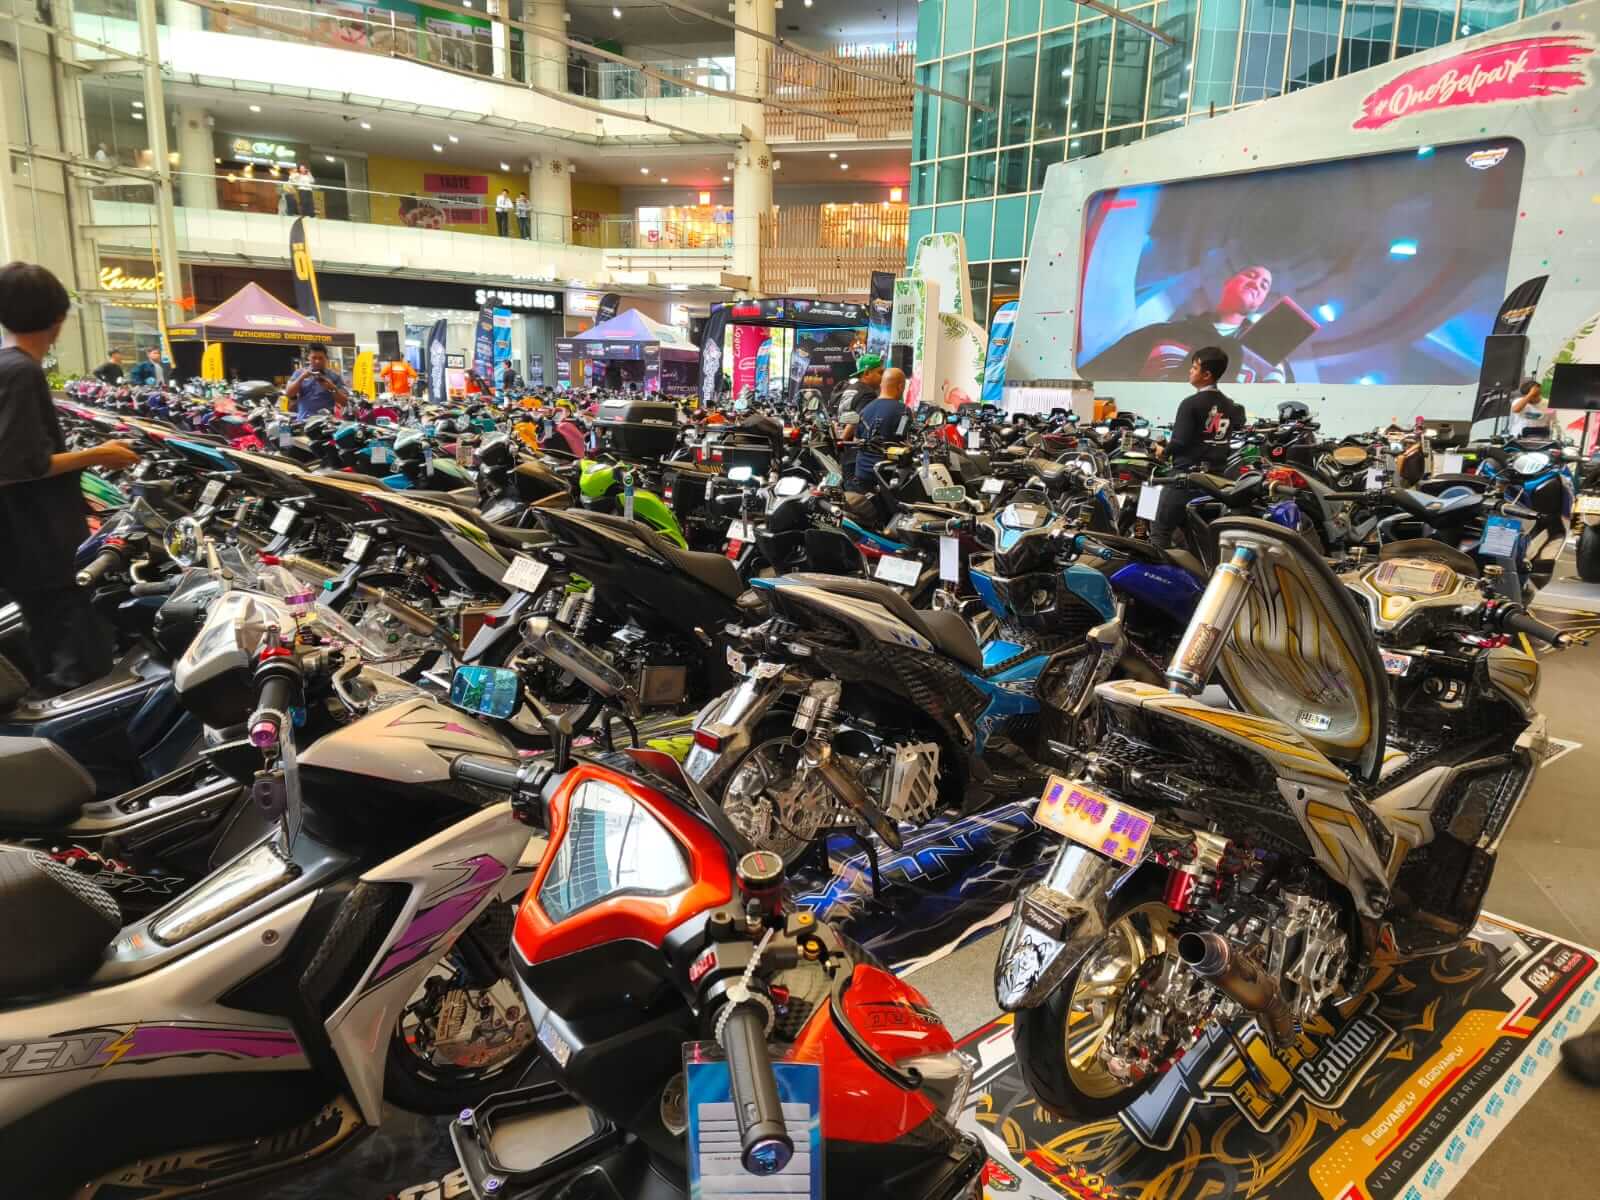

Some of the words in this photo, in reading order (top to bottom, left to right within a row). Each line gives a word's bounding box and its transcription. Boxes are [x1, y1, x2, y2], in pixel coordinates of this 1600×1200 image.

[1375, 50, 1528, 116] #OneBelpark
[898, 303, 915, 315] LIGHT
[906, 317, 915, 328] UP
[898, 329, 914, 340] YOUR
[1298, 1018, 1377, 1096] Carbon
[1402, 1106, 1453, 1160] CONTEST
[1450, 1064, 1494, 1107] PARKING
[1490, 1037, 1514, 1067] ONLY
